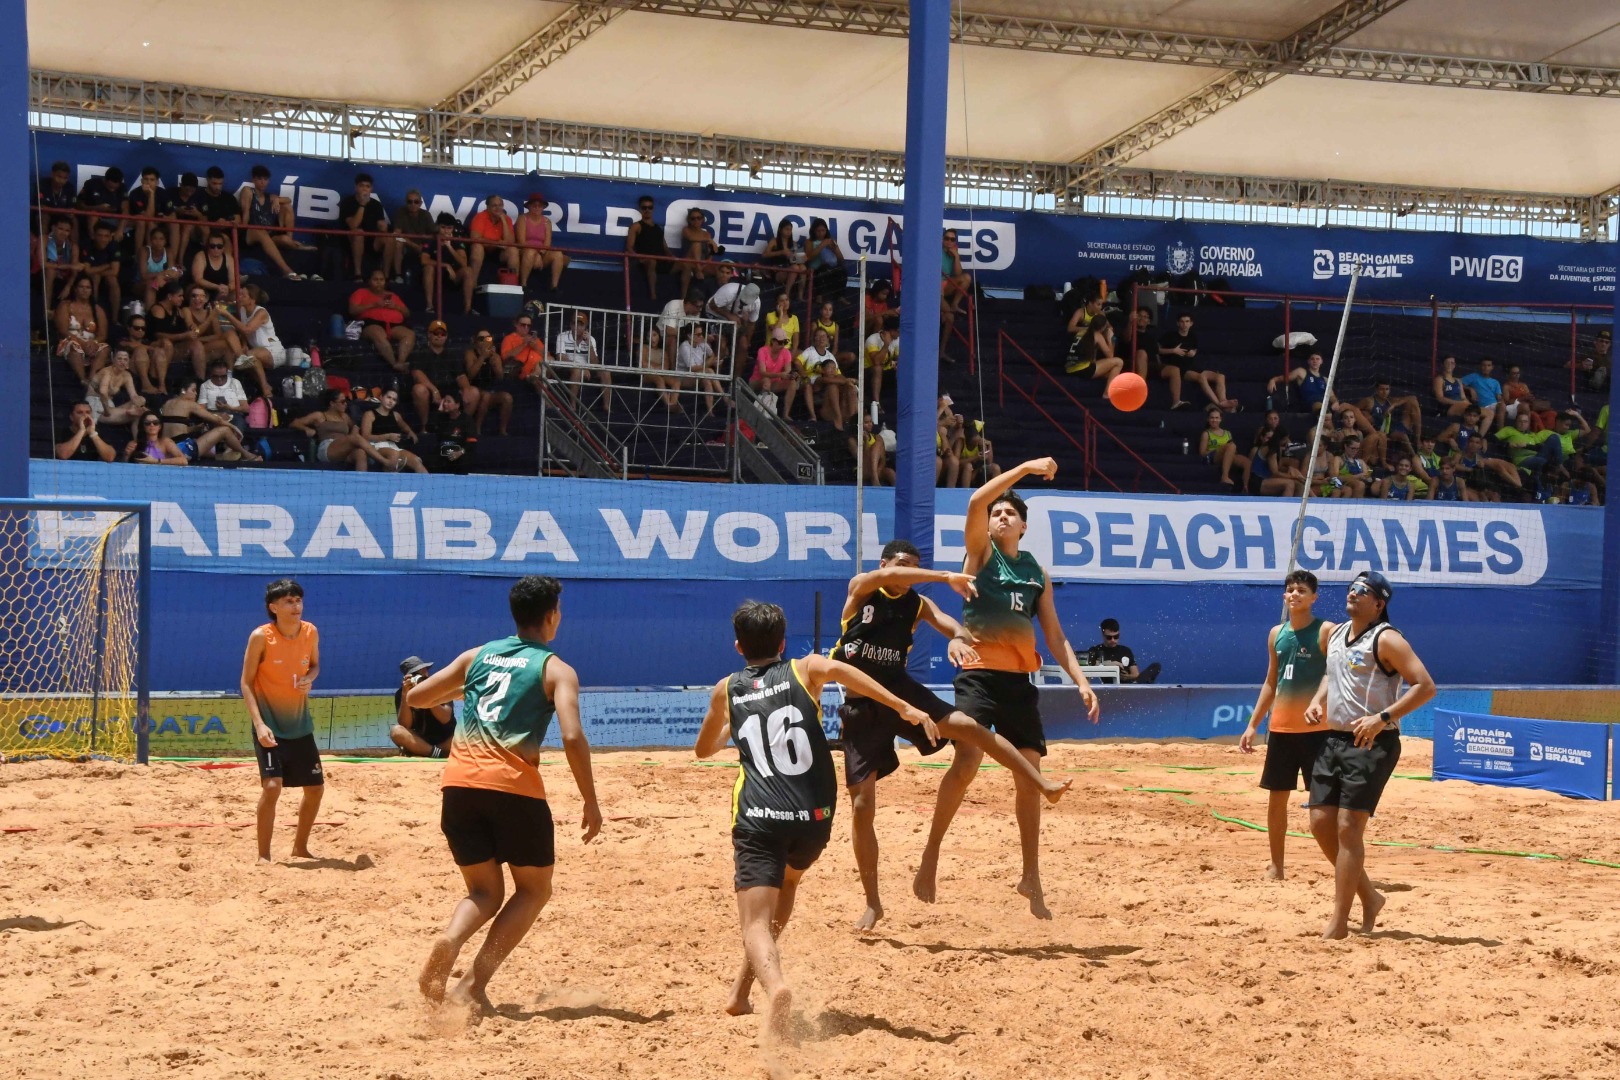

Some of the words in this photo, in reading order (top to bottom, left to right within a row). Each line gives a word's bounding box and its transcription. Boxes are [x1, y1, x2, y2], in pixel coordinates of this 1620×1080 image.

[1087, 241, 1121, 250] SECRETARIA
[1132, 243, 1155, 252] ESTADO
[1200, 246, 1255, 260] GOVERNO
[1089, 252, 1127, 261] JUVENTUDE,
[1338, 252, 1373, 264] BEACH
[1375, 254, 1414, 265] GAMES
[1199, 262, 1214, 276] DA
[1216, 261, 1263, 277] PARAÍBA
[1338, 263, 1402, 279] BRAZIL
[1450, 256, 1519, 280] PWBG
[1558, 265, 1587, 273] SECRETARIA
[35, 491, 580, 563] PARAÍBA
[1048, 510, 1276, 571] BEACH
[1294, 514, 1524, 575] GAMES
[1010, 591, 1024, 611] 15
[862, 604, 874, 624] 8
[477, 670, 512, 722] 2
[1467, 728, 1513, 738] PARAÍBA
[738, 704, 814, 779] 16
[1467, 736, 1506, 745] WORLD
[1469, 745, 1490, 753] BEACH
[1491, 747, 1513, 755] GAMES
[1545, 746, 1567, 754] BEACH
[1568, 748, 1592, 758] GAMES
[1545, 753, 1585, 765] BRAZIL
[765, 807, 794, 820] Pessoa
